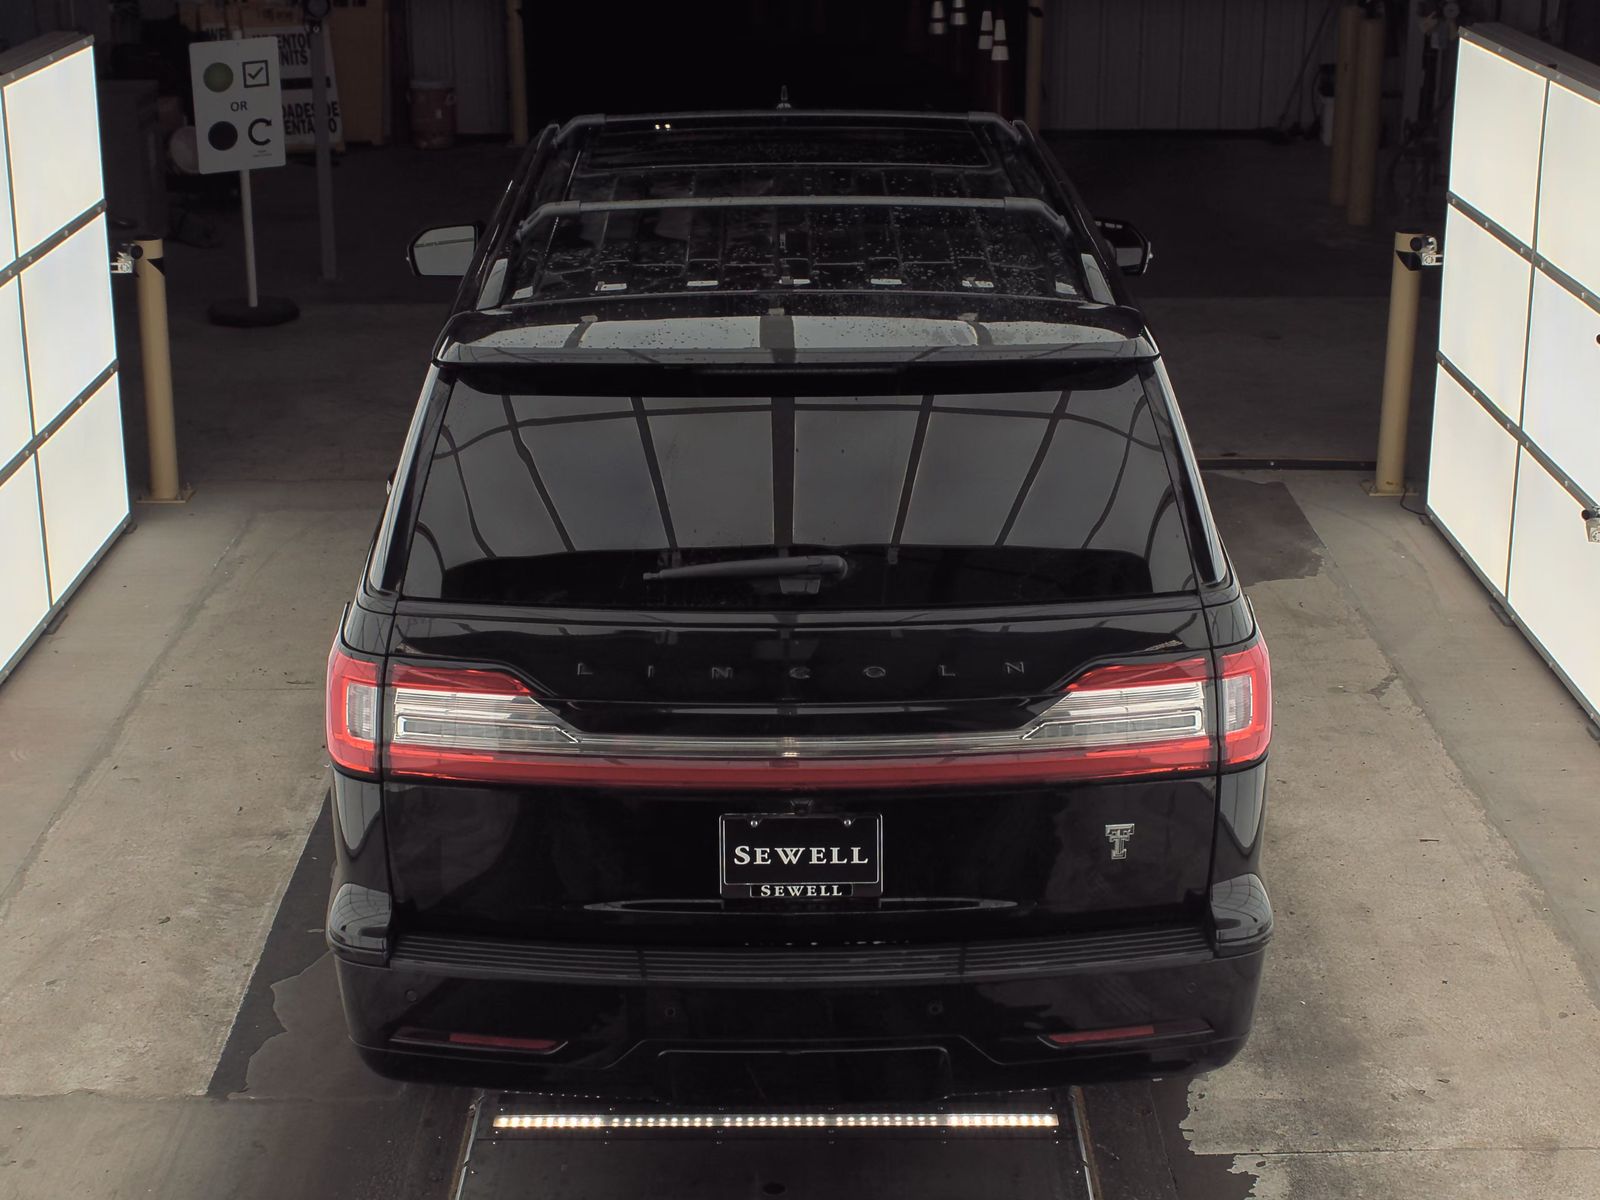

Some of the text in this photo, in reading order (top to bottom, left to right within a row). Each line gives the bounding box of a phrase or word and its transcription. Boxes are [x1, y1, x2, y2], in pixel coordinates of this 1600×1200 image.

[280, 49, 308, 66] NITS
[230, 100, 248, 112] OR
[577, 660, 1026, 681] LINCOLN
[733, 845, 869, 865] SEWELL
[760, 885, 843, 897] SEWELL
